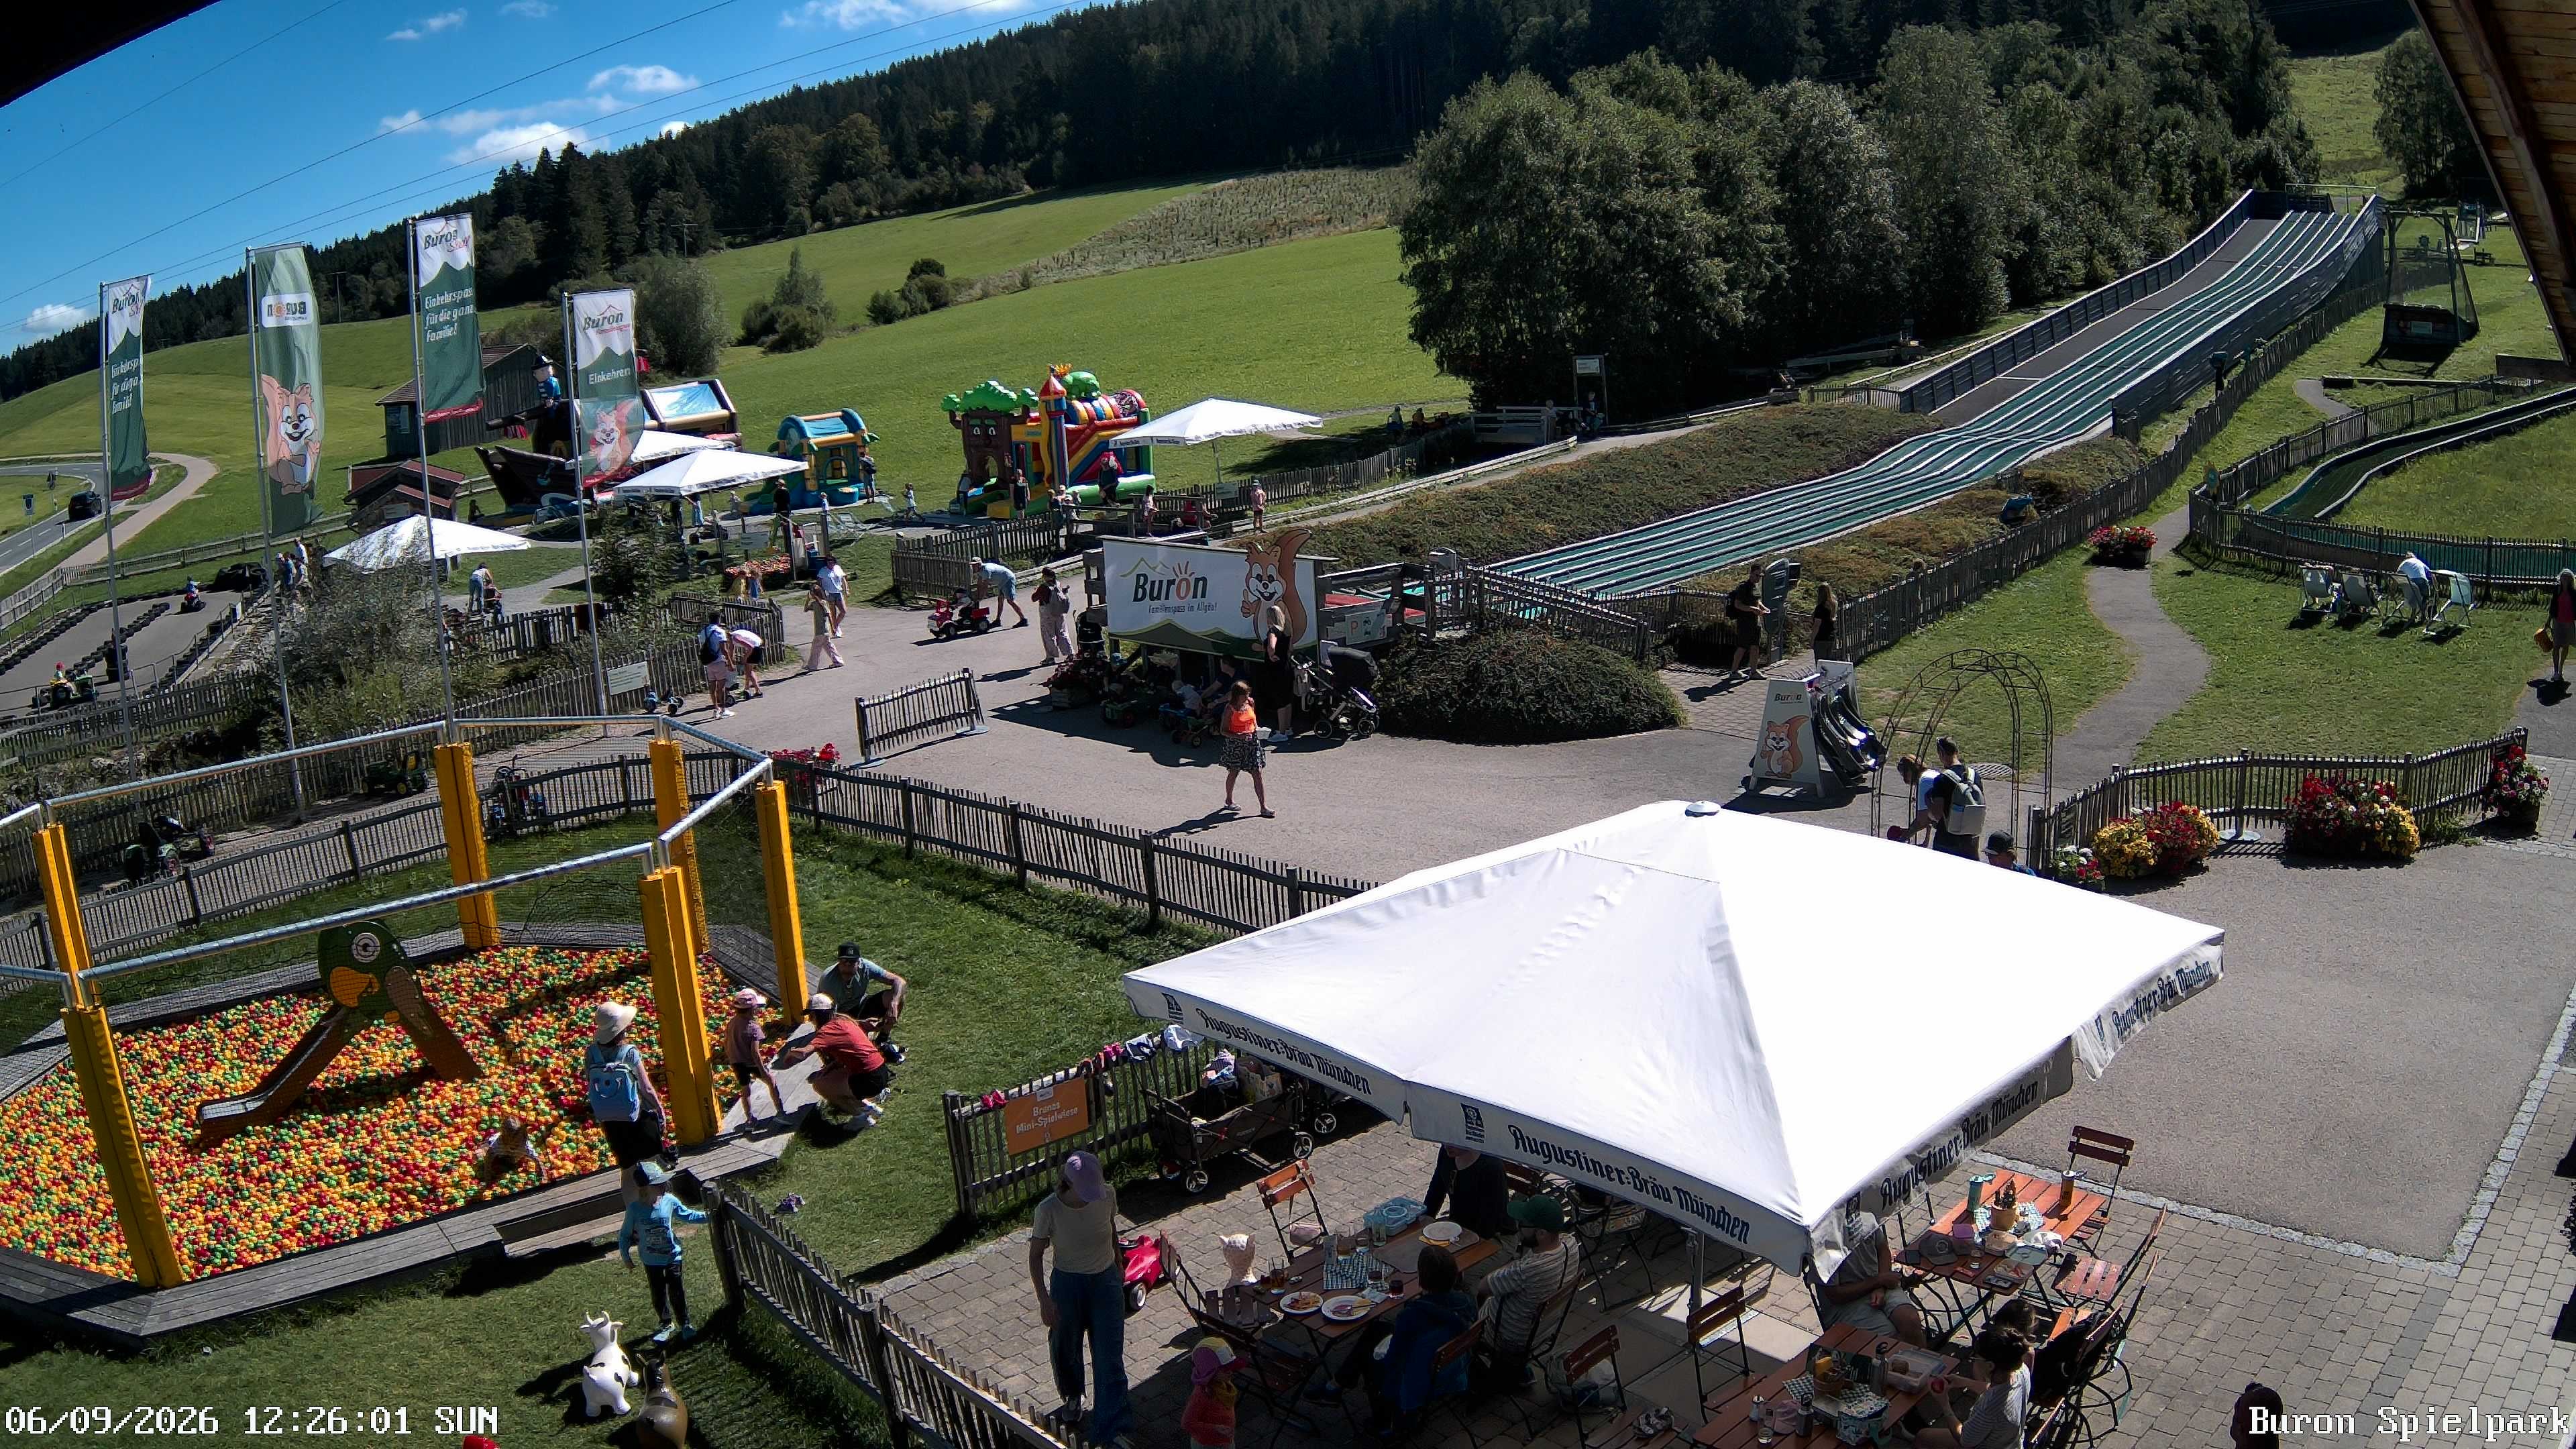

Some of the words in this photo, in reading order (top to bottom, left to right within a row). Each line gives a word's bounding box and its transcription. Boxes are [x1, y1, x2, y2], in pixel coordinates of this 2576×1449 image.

[424, 229, 458, 250] Buron
[584, 312, 623, 330] Buron
[1132, 570, 1208, 602] Buron
[1310, 1053, 1372, 1095] München
[1991, 1081, 2038, 1127] München
[1673, 1185, 1750, 1244] München
